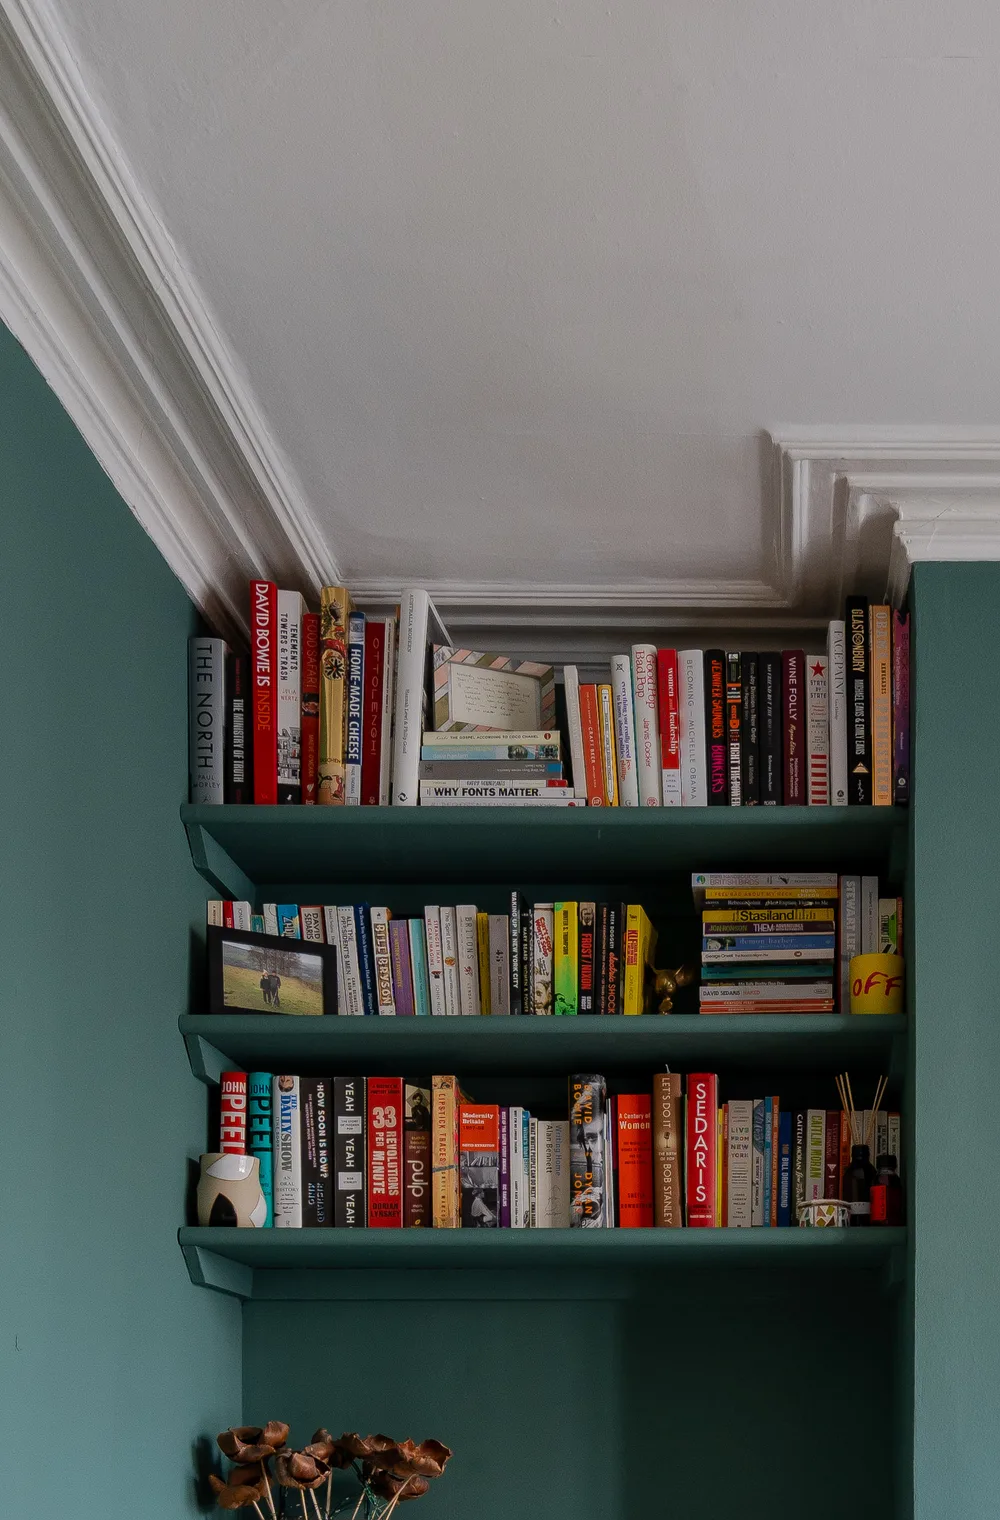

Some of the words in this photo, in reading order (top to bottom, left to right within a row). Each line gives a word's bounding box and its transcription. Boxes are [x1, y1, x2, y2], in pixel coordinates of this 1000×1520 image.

[256, 584, 268, 626] DAVID
[280, 613, 288, 646] TOWERS
[307, 619, 317, 649] FOOD
[257, 630, 270, 675] BOWIE
[290, 624, 298, 673] TENEMENTS,
[636, 650, 646, 673] Bad
[197, 645, 212, 682] THE
[280, 656, 288, 681] TRASH
[307, 650, 317, 688] SAFARI
[646, 654, 656, 685] Good
[788, 657, 796, 685] WINE
[257, 676, 270, 686] IS
[350, 649, 361, 718] HOME-MADE
[636, 677, 646, 698] Pop
[711, 660, 722, 698] JENNIFER
[233, 699, 244, 712] THE
[257, 690, 270, 731] INSIDE
[370, 638, 380, 755] OTTOLENGHI
[646, 688, 656, 708] Pop
[789, 688, 797, 720] FOLLY
[197, 693, 213, 768] NORTH
[233, 713, 244, 747] MINISTRY
[643, 718, 651, 740] Jarvis
[669, 711, 679, 754] leadership
[712, 700, 724, 738] SAUNDERS
[233, 750, 244, 758] OF
[349, 722, 359, 760] CHEESE
[644, 742, 652, 767] Cocker
[233, 760, 244, 782] TRUTH
[711, 745, 725, 793] BONKERS
[435, 788, 459, 796] WHY
[462, 788, 495, 796] FONTS
[500, 788, 541, 796] MATTER.
[740, 910, 794, 921] Stasiland
[846, 880, 855, 931] STEWART
[304, 913, 313, 940] SEDARIS
[512, 918, 517, 927] UP
[374, 924, 387, 953] BILL
[465, 916, 474, 959] BRITONS
[582, 933, 592, 958] FROST
[847, 932, 855, 950] LEE
[496, 949, 503, 962] 45
[609, 952, 618, 982] electric
[378, 957, 391, 1005] BRYSON
[581, 964, 591, 990] NIXON
[851, 971, 903, 998] OFF
[608, 984, 616, 1013] SHOCK
[222, 1082, 246, 1093] JOHN
[250, 1085, 270, 1093] JOHN
[346, 1083, 354, 1112] YEAH
[662, 1078, 670, 1100] LET'S
[373, 1106, 397, 1129] 33
[574, 1083, 582, 1125] BOWIE
[584, 1084, 592, 1124] DAVID
[663, 1103, 671, 1118] DO
[220, 1095, 246, 1154] PEEL
[318, 1110, 326, 1136] SOON
[620, 1121, 650, 1129] Women
[663, 1119, 671, 1127] IT
[811, 1116, 822, 1146] CAITLIN
[319, 1139, 326, 1148] IS
[346, 1138, 354, 1167] YEAH
[375, 1132, 384, 1146] PER
[694, 1083, 708, 1202] SEDARIS
[320, 1151, 329, 1178] NOW?
[372, 1151, 385, 1194] MINUTE
[386, 1131, 399, 1196] REVOLUTIONS
[663, 1164, 671, 1182] BOB
[781, 1157, 789, 1170] BILL
[810, 1149, 822, 1178] MORAN
[407, 1160, 428, 1197] pulp
[574, 1172, 582, 1213] JONES
[346, 1194, 355, 1223] YEAH
[663, 1184, 672, 1224] STANLEY
